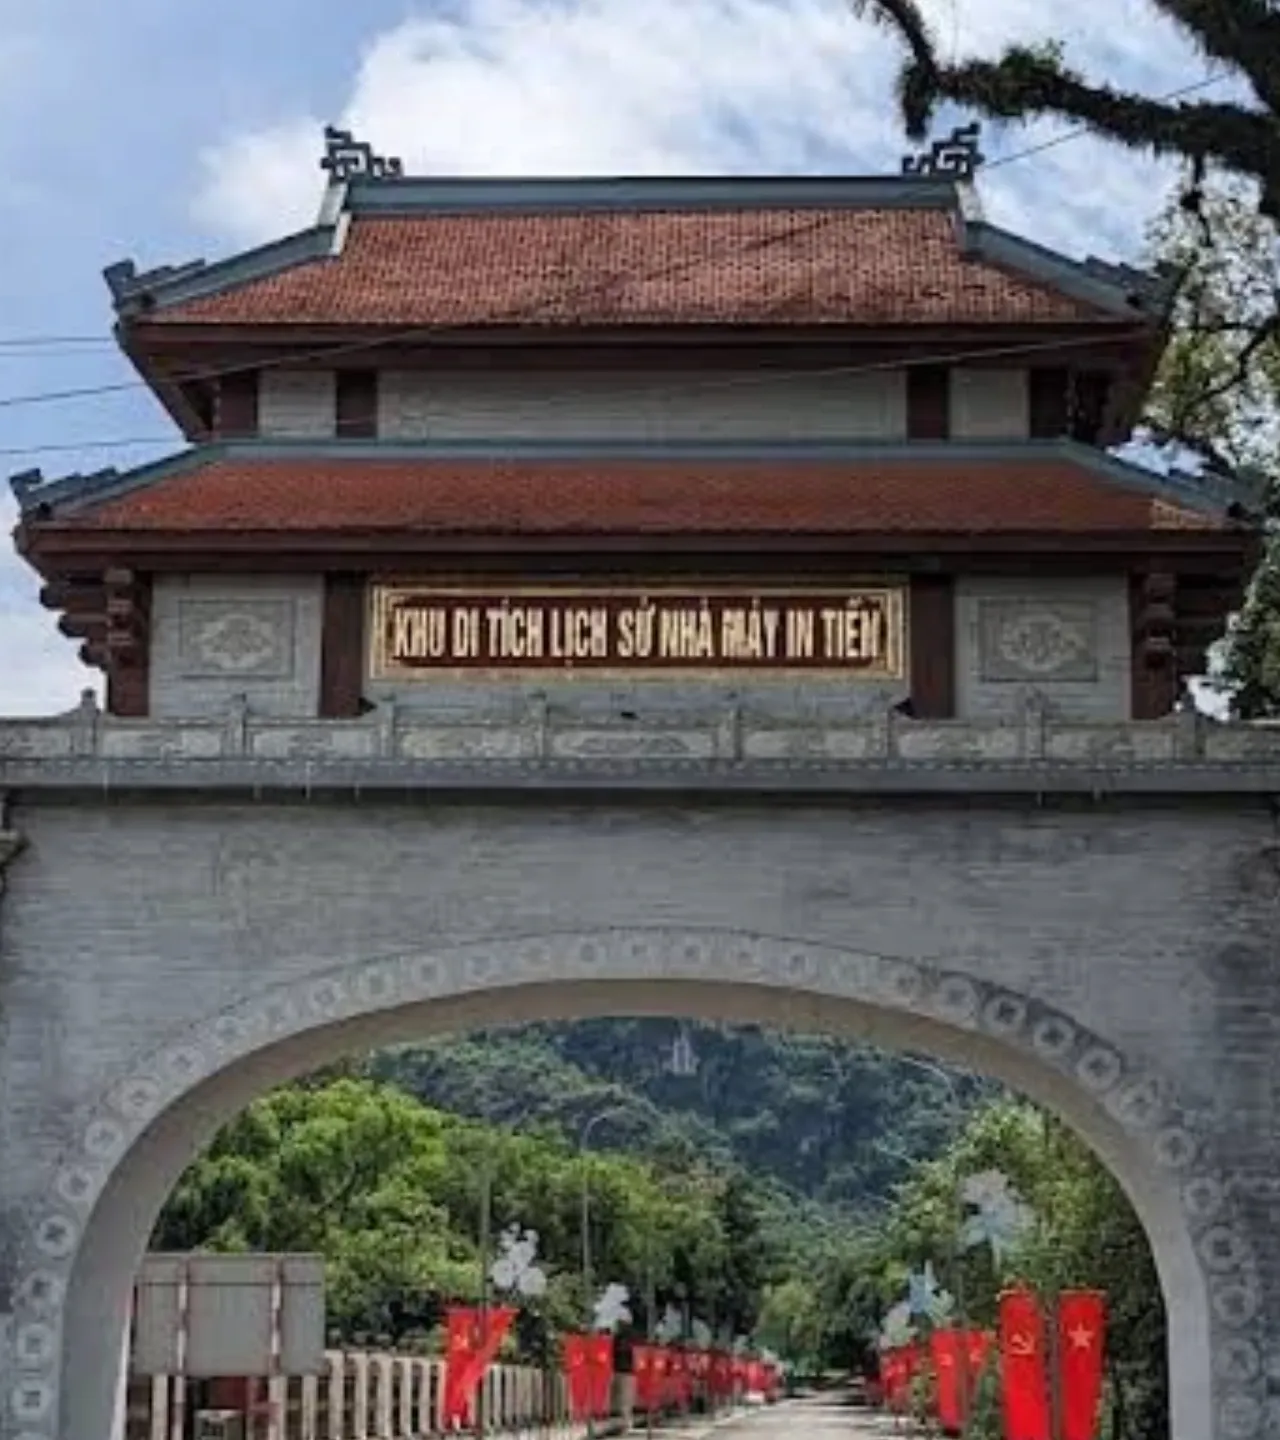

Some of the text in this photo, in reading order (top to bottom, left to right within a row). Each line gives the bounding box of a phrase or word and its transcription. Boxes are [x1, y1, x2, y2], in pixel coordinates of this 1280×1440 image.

[395, 607, 446, 657] KHU
[452, 608, 479, 657] DI
[550, 608, 607, 668] LỊCH
[786, 608, 813, 657] IN
